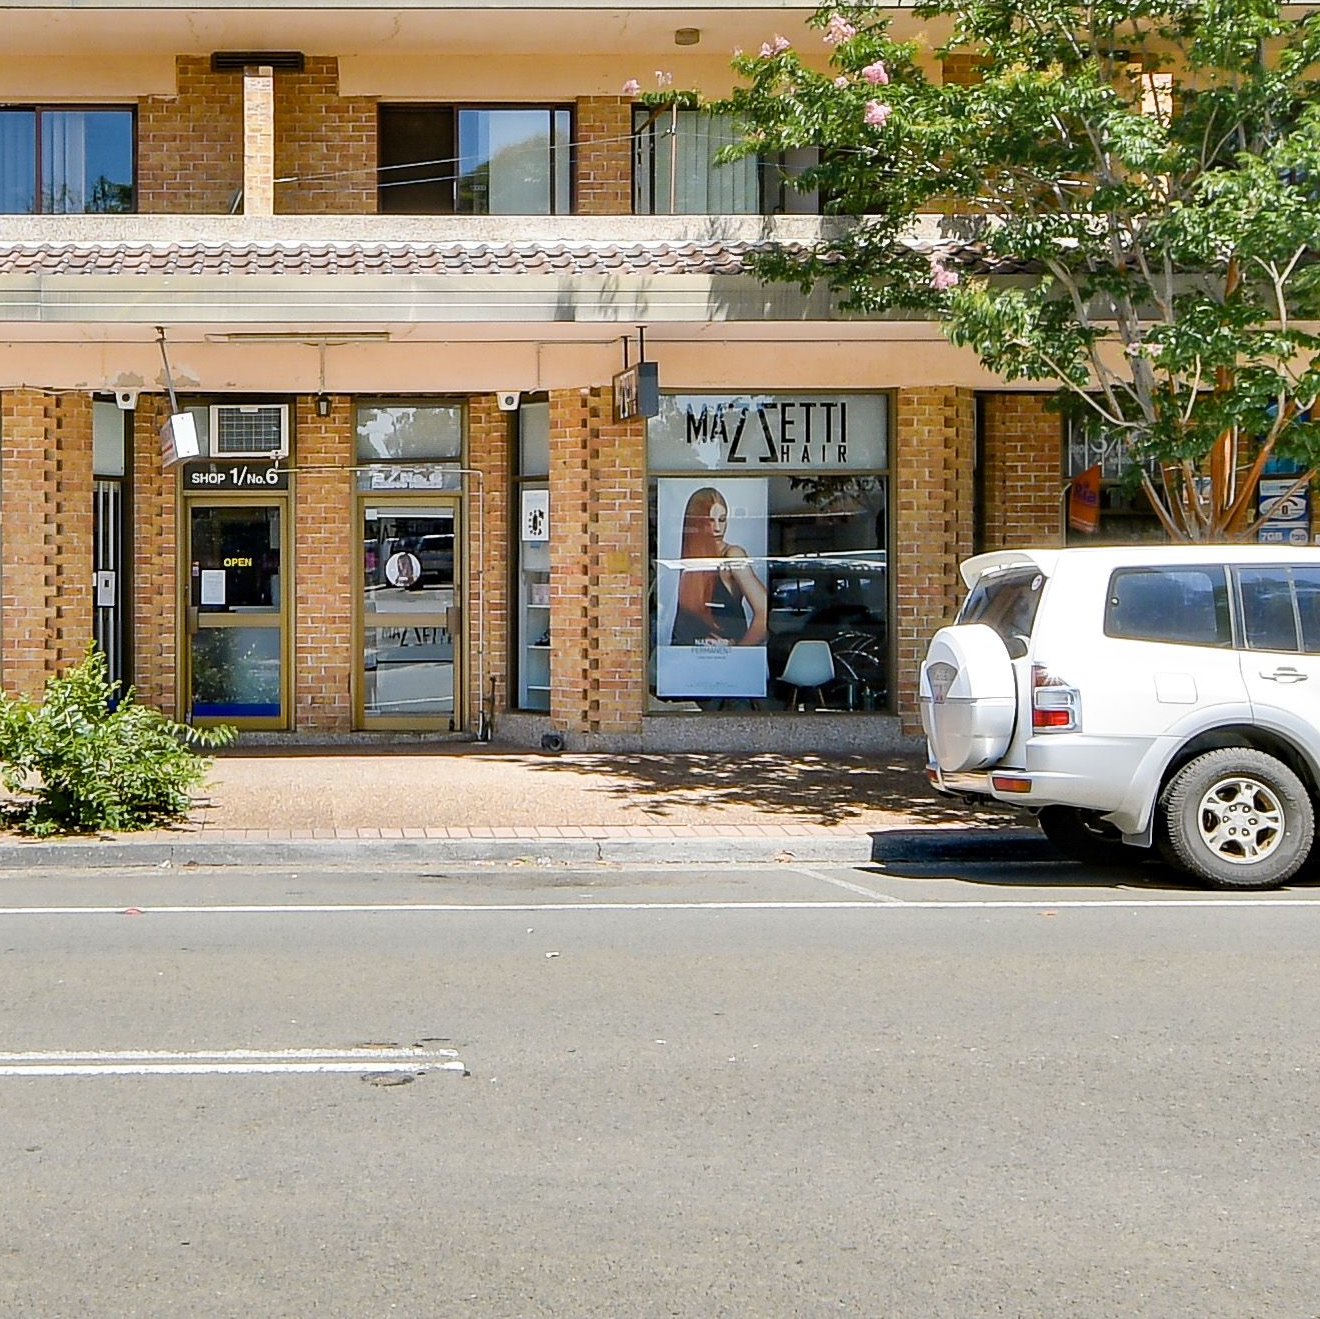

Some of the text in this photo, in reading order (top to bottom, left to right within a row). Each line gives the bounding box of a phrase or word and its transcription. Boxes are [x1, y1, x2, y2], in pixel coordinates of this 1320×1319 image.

[686, 401, 847, 463] MAZZETTI
[781, 444, 847, 463] HAIR
[191, 465, 279, 486] SHOP 1/No.6
[223, 557, 253, 567] OPEN
